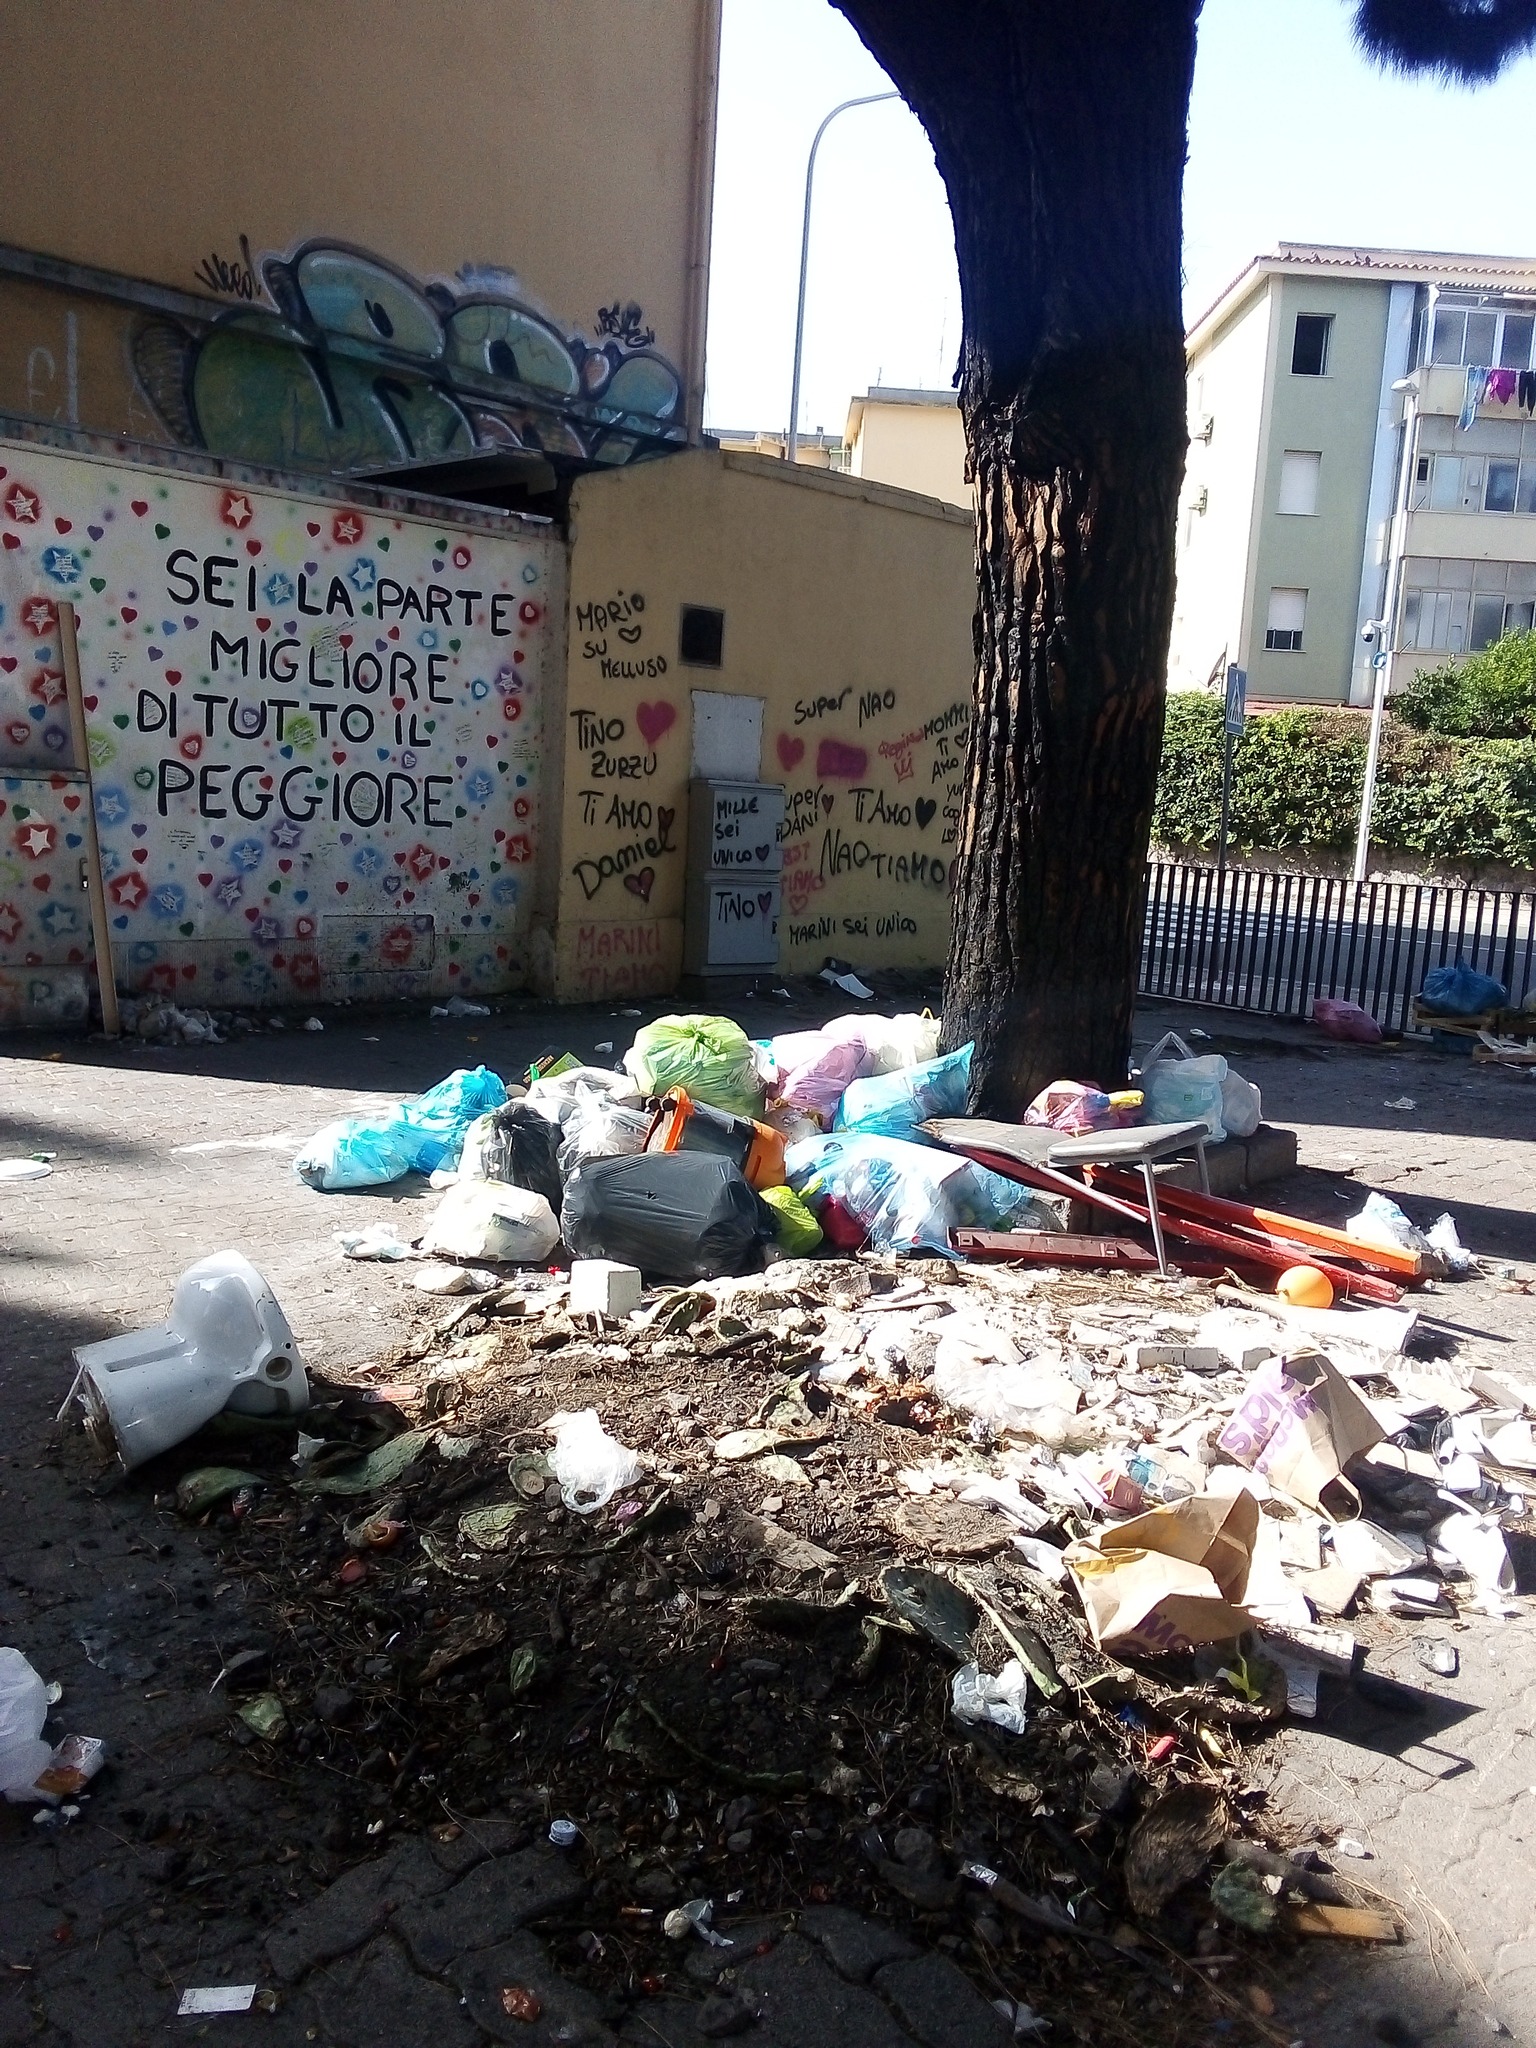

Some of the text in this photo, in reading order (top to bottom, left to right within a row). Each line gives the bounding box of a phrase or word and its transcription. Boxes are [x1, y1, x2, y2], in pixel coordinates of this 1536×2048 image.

[166, 549, 516, 636] SEI LA PARTE
[210, 630, 454, 704] MIGLIORE
[582, 639, 608, 659] SU
[137, 689, 177, 739] DI
[193, 693, 375, 743] TUTTO
[395, 713, 431, 747] IL
[858, 688, 896, 729] NAO
[591, 751, 657, 779] ZURZU
[931, 757, 959, 785] AMO
[157, 758, 453, 828] PEGGIORE
[605, 793, 652, 830] AMO
[716, 796, 760, 820] MILLE
[868, 790, 911, 826] AMO
[715, 891, 756, 924] TINO
[577, 921, 661, 959] MARINI
